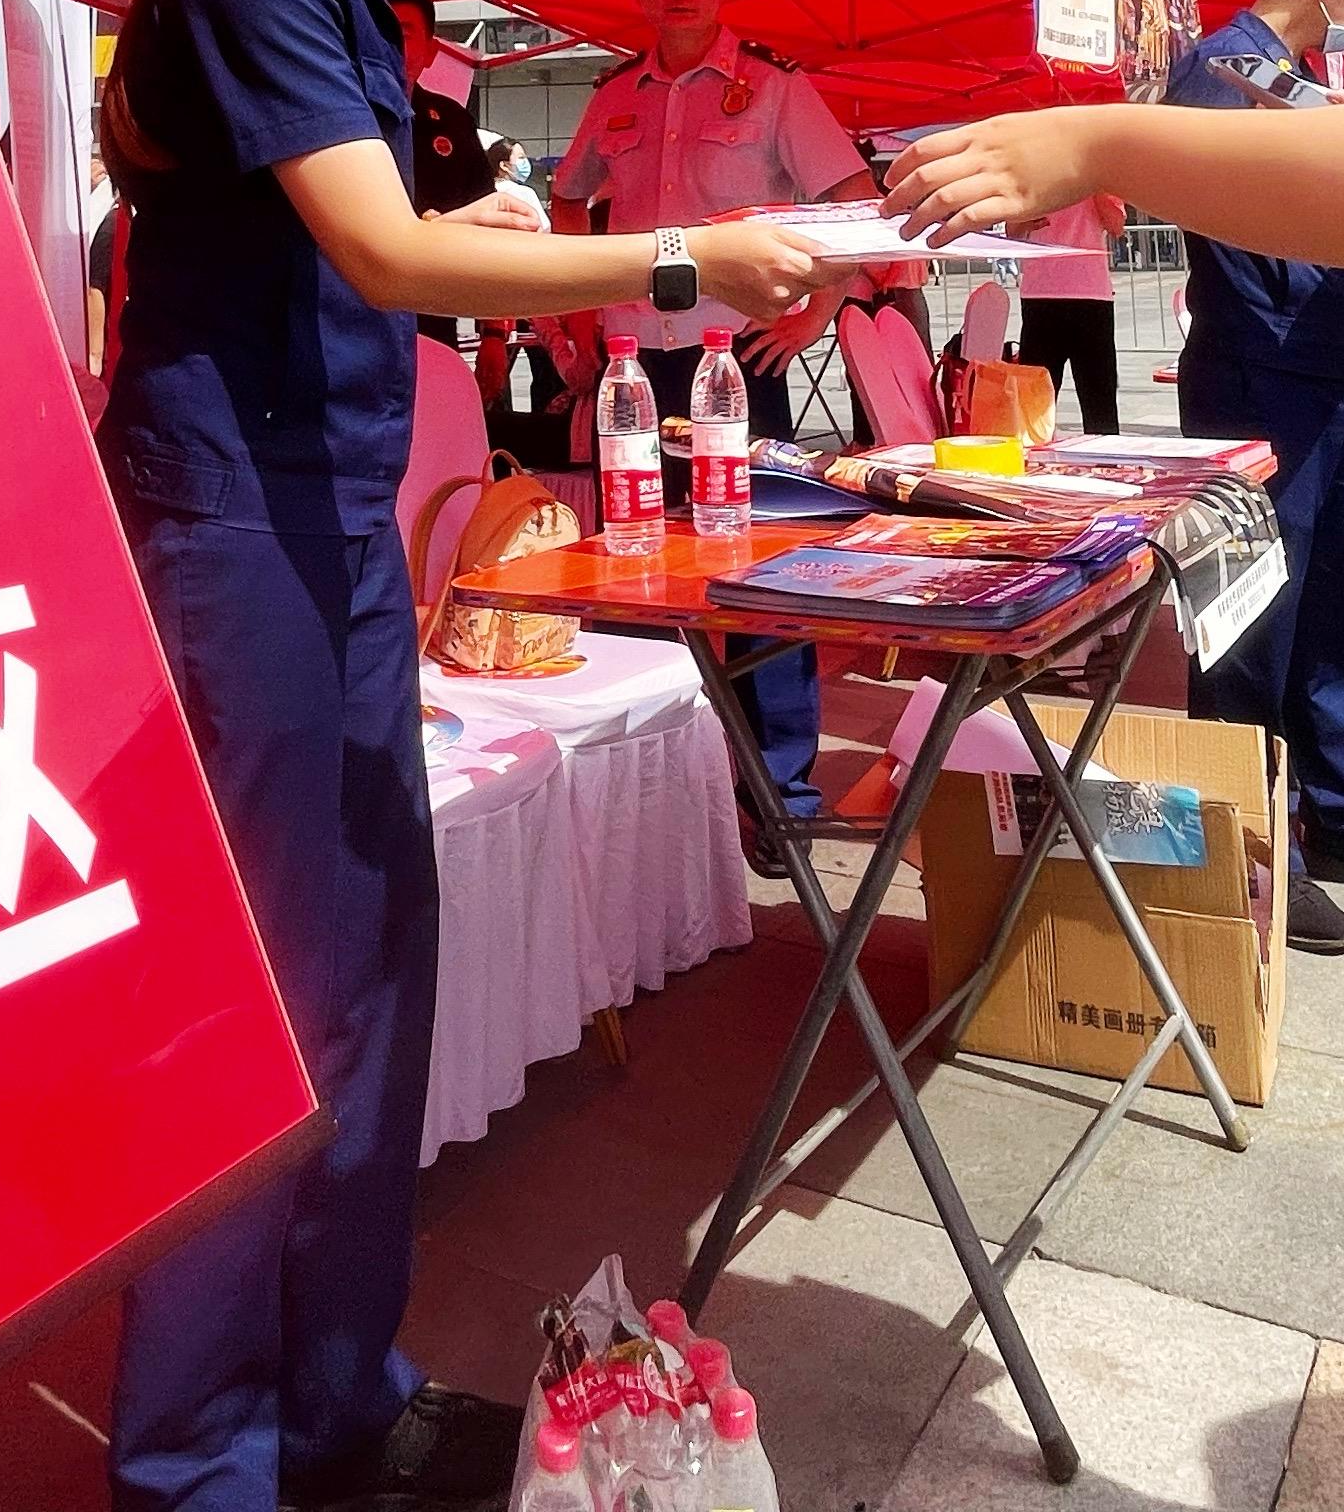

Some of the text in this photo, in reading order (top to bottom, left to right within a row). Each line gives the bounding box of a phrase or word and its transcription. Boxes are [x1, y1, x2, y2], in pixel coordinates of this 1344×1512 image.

[1057, 1000, 1217, 1049] 精美画册箱
